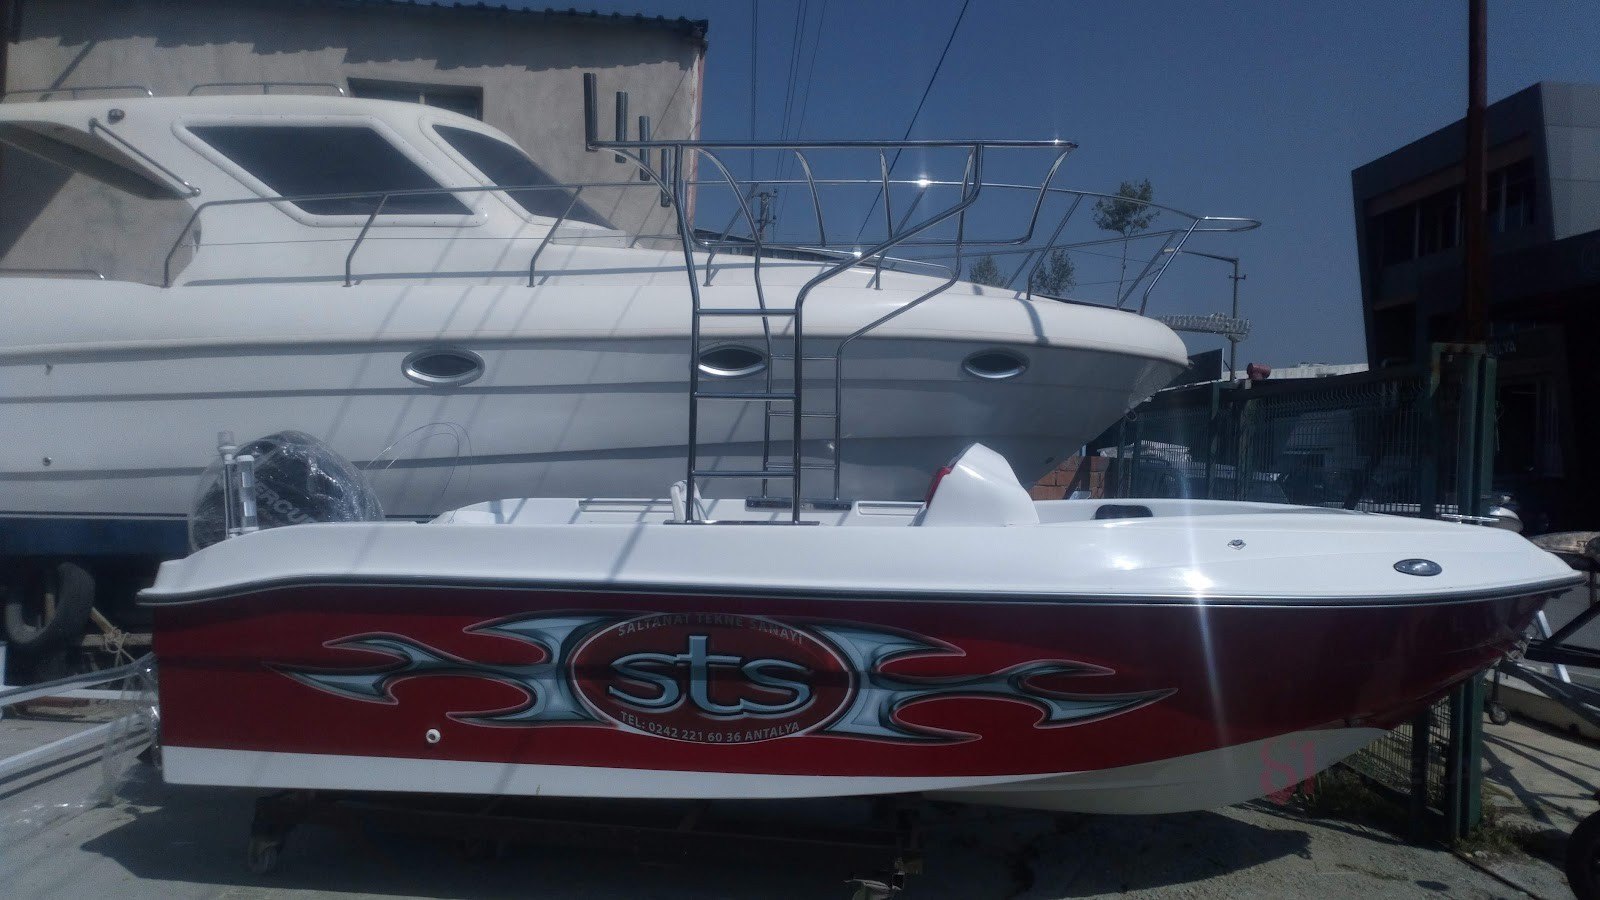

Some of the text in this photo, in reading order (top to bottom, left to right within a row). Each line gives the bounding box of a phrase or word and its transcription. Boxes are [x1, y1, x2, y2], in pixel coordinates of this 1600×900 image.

[618, 614, 689, 636] SALTANAT
[697, 613, 744, 628] TEKNE
[608, 635, 815, 719] sts
[620, 710, 800, 742] TEL: 0242 221 60 36 ANTALYA
